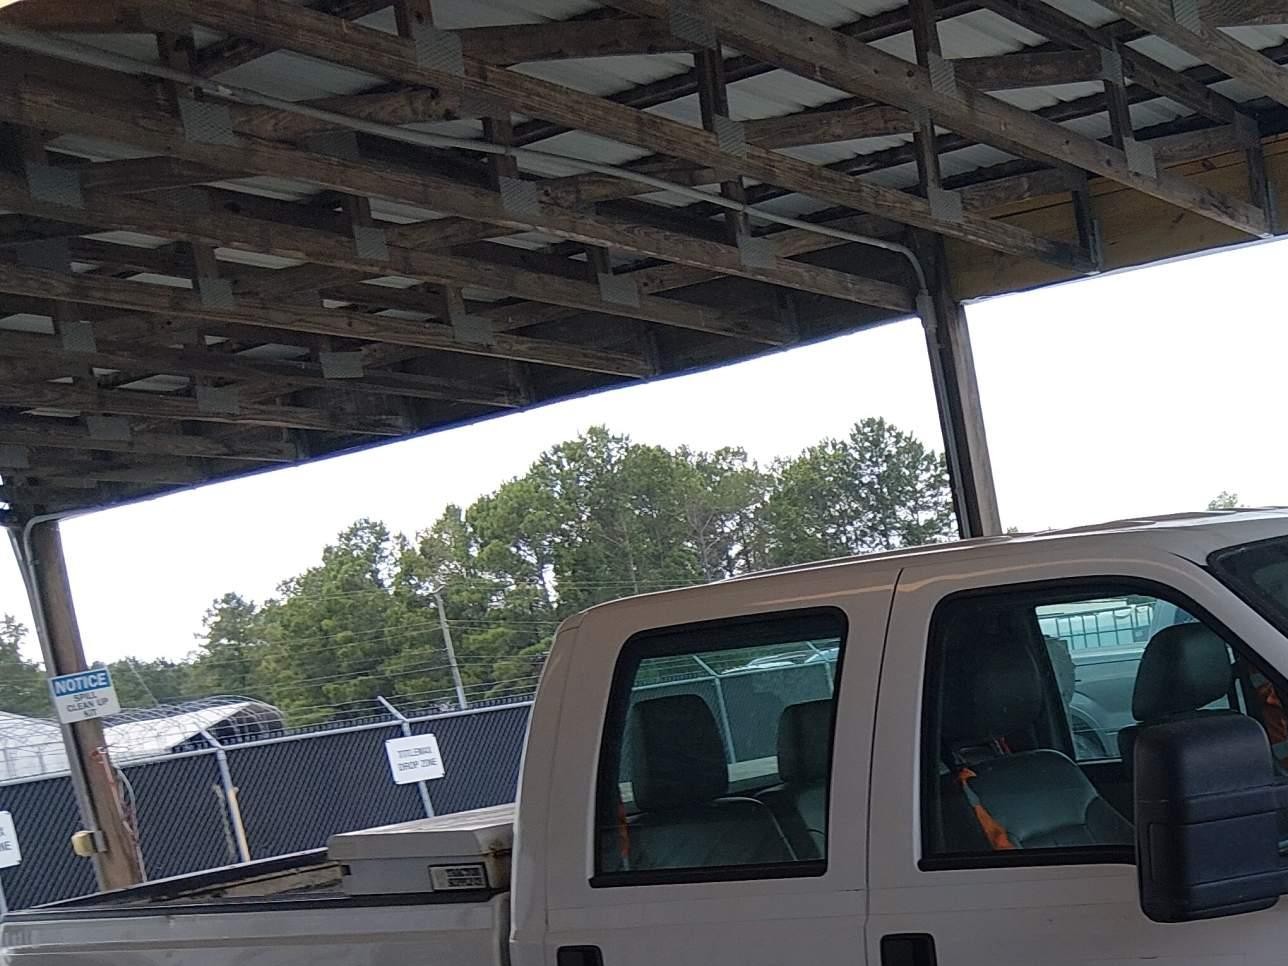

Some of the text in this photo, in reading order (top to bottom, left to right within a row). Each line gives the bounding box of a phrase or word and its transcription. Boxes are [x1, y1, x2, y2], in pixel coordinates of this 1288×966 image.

[54, 672, 108, 694] NOTICE
[66, 697, 109, 713] CLEAN UP
